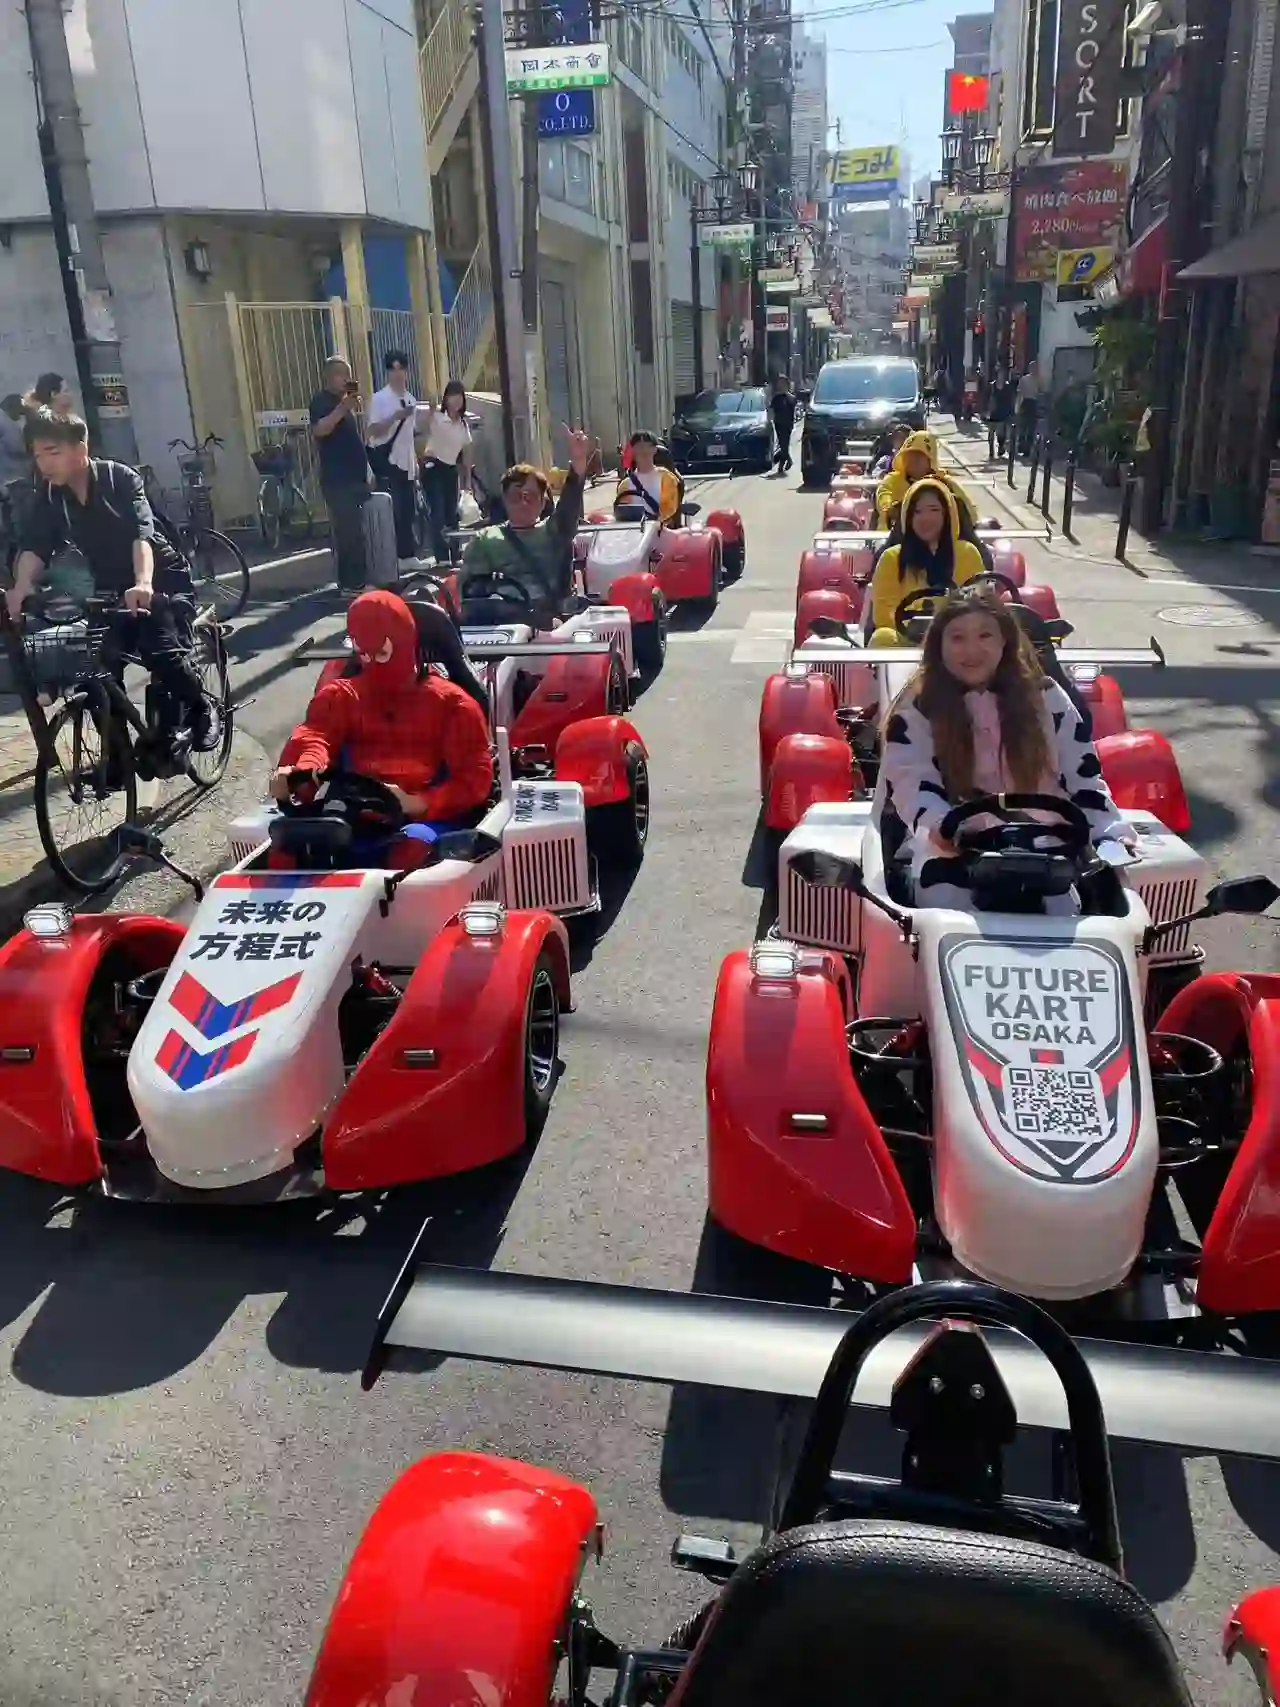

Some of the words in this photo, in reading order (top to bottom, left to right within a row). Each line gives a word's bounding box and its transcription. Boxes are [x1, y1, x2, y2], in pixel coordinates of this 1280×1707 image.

[218, 900, 328, 925] 未来の
[189, 931, 323, 961] 方程式
[964, 964, 1109, 993] FUTURE
[985, 992, 1095, 1022] KART
[991, 1022, 1096, 1045] OSAKA
